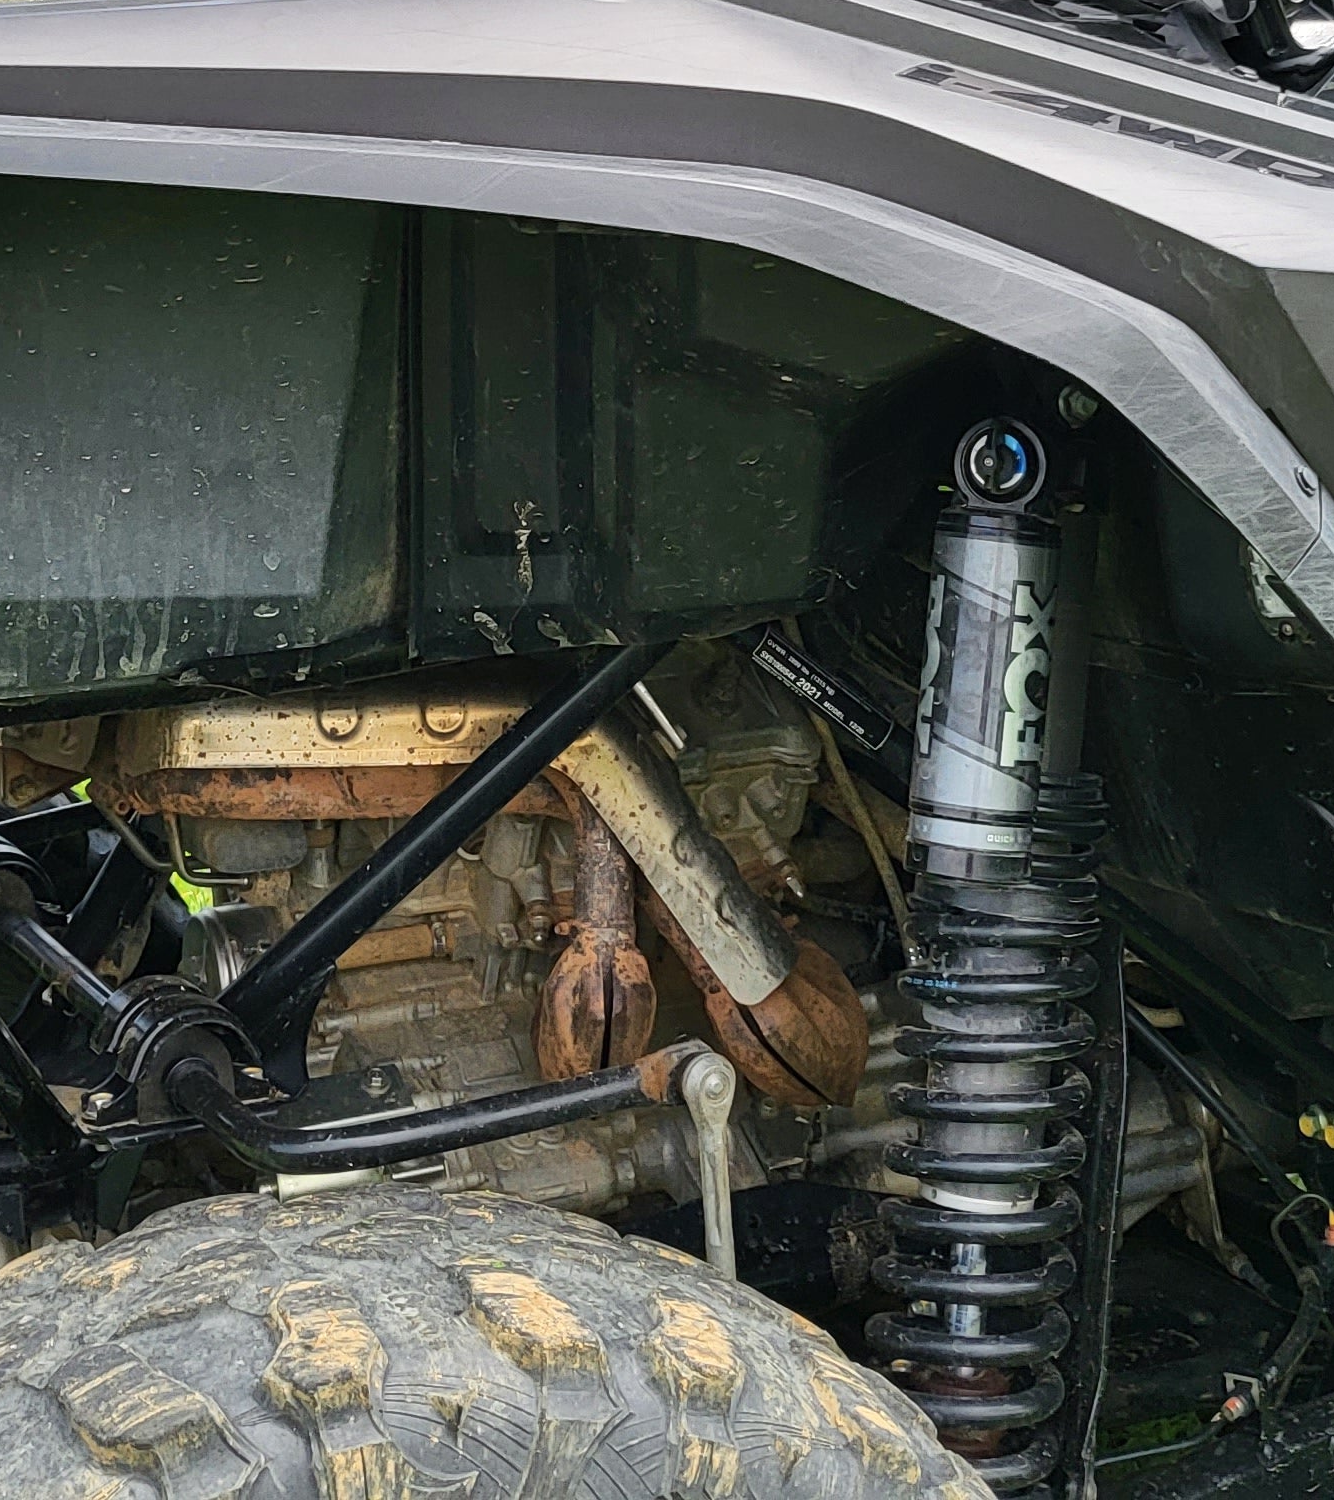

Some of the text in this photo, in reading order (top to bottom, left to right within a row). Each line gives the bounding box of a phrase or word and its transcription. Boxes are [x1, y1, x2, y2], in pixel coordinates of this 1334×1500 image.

[796, 677, 822, 700] 2021
[823, 701, 845, 721] MODEL
[1000, 583, 1058, 768] FOX
